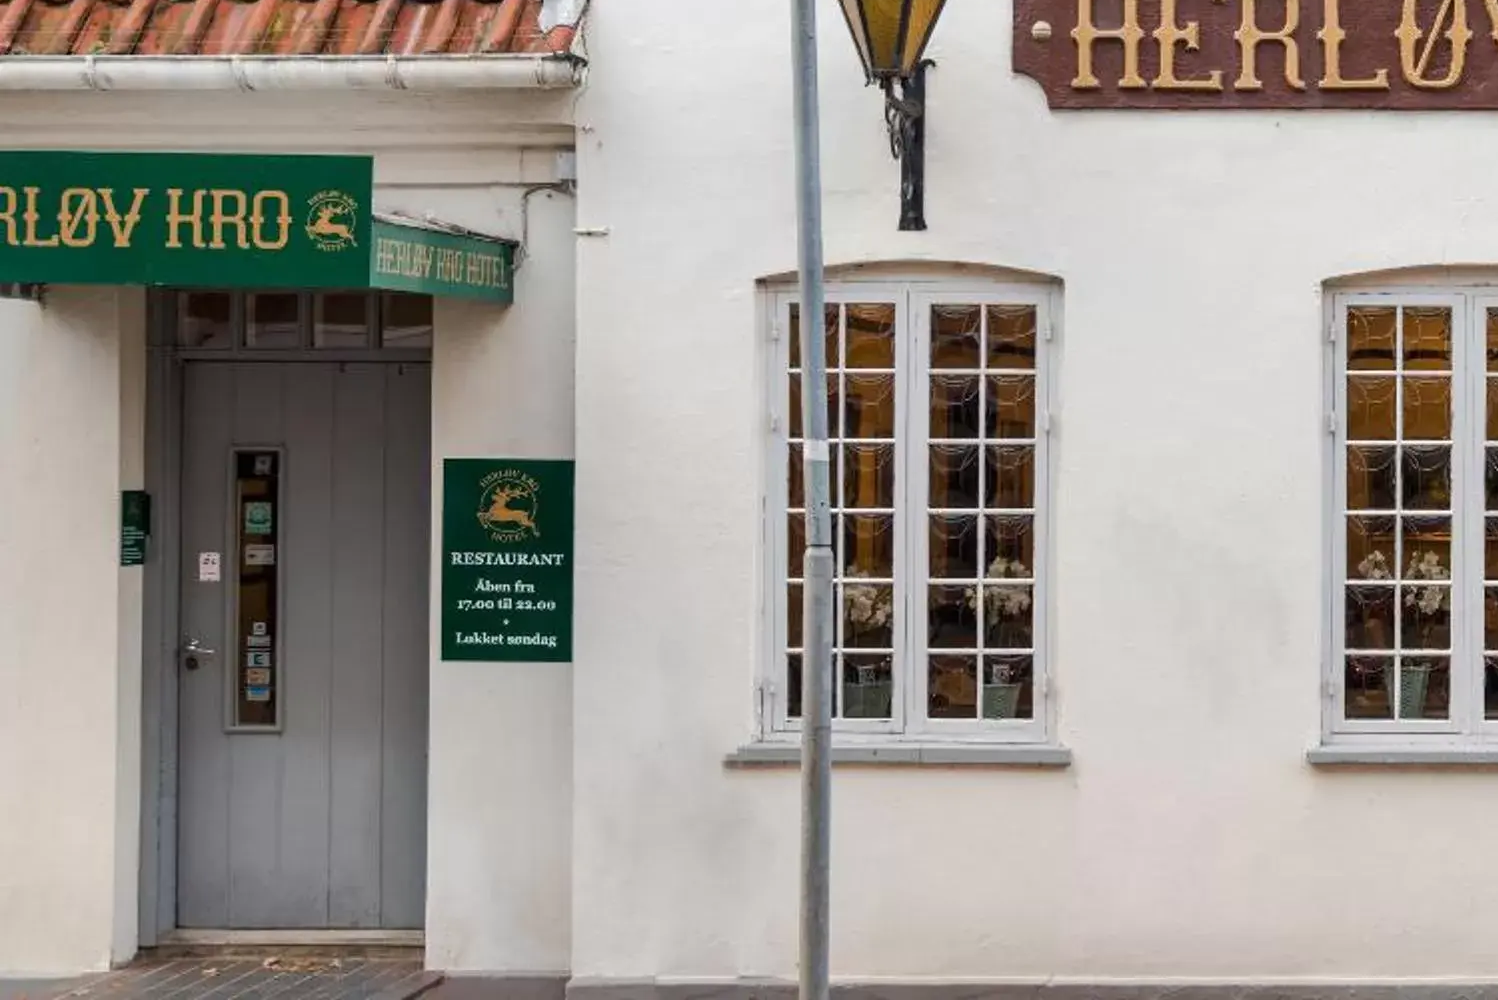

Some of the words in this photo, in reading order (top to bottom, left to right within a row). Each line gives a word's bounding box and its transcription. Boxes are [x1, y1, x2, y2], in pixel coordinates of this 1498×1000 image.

[165, 188, 292, 250] KRO
[467, 251, 508, 289] HOTEL
[450, 551, 565, 566] RESTAURANT
[475, 578, 511, 593] Åben
[514, 579, 536, 593] fra
[457, 599, 495, 612] 17.00
[497, 597, 513, 610] til
[515, 599, 557, 611] 22.00
[506, 631, 558, 648] søndag
